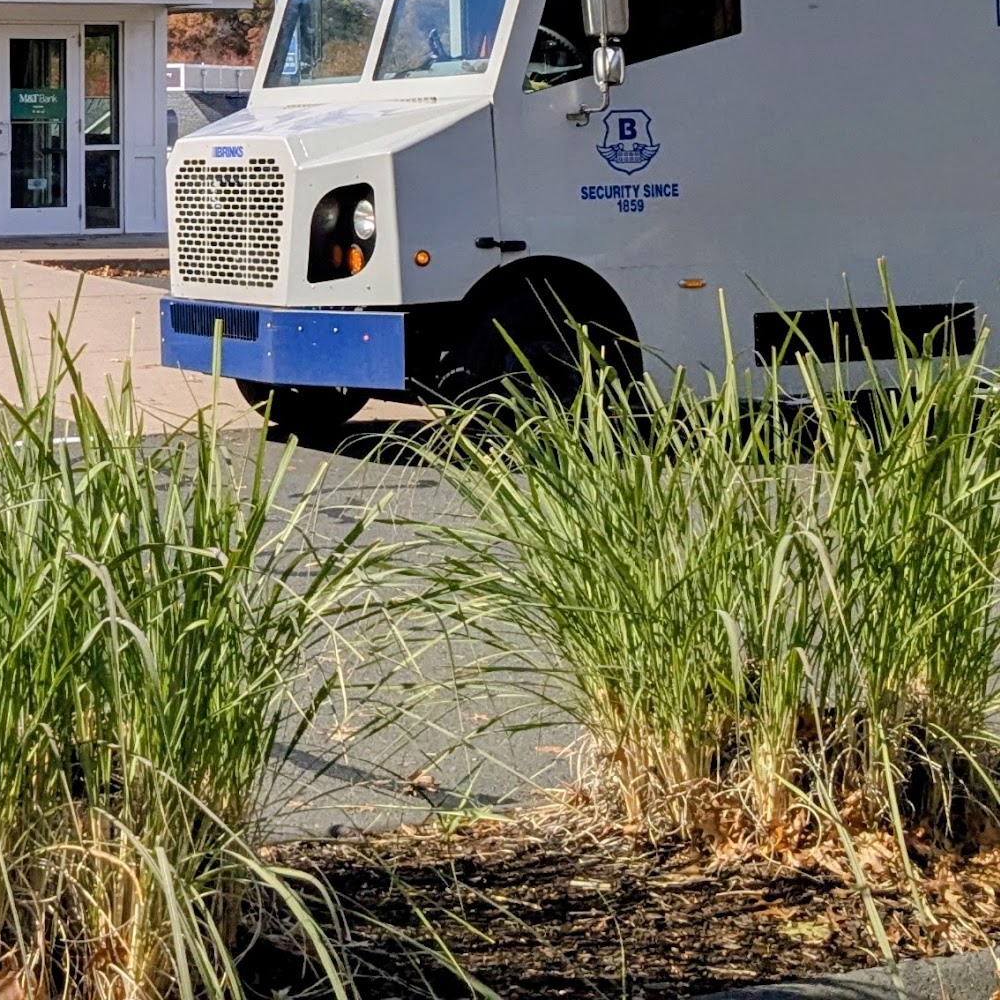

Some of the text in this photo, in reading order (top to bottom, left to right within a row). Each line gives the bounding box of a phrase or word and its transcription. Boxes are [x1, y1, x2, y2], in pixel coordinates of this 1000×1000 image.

[18, 93, 58, 104] M&T Bank
[618, 118, 638, 140] B
[580, 183, 680, 200] SECURITY SINCE
[617, 199, 645, 213] 1859
